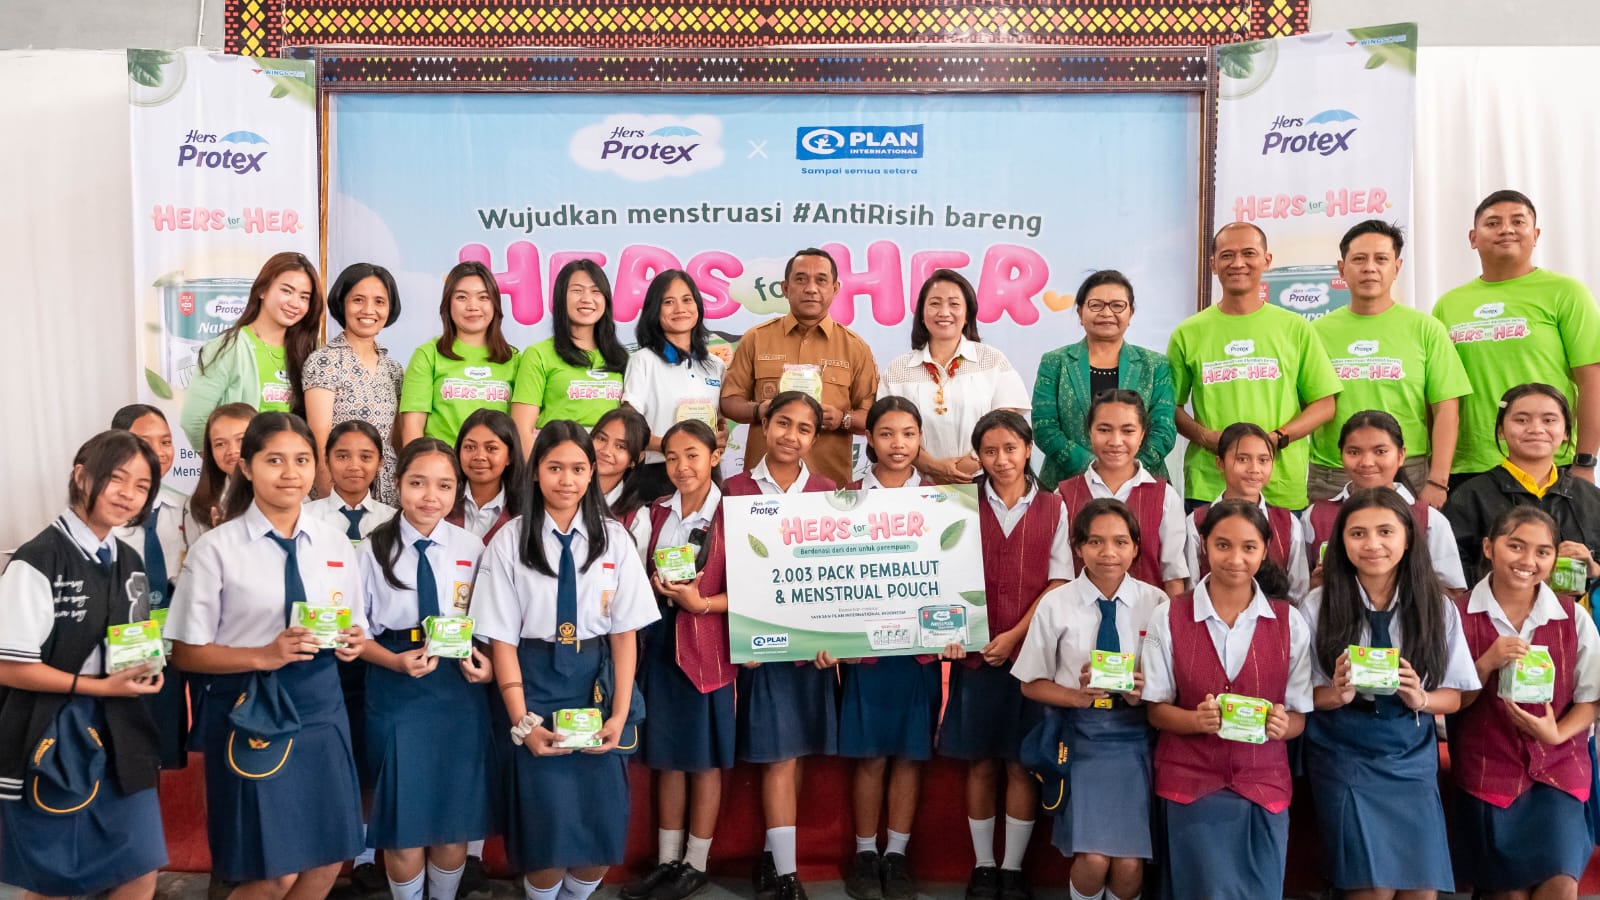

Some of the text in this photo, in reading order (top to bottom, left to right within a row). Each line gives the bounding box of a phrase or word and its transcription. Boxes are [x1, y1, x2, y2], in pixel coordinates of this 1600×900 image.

[610, 126, 645, 139] Hers
[1271, 115, 1304, 131] Hers
[185, 130, 217, 144] Hers
[850, 132, 918, 147] PLAN
[1262, 128, 1357, 156] Protex
[178, 144, 268, 175] Protex
[601, 140, 700, 165] Protex
[801, 167, 842, 176] Sampai
[1233, 187, 1388, 222] HERS for HER
[152, 204, 299, 233] HERS for HER
[478, 202, 1042, 237] Wujudkan menstruasi #AntiRisih bareng
[1289, 293, 1321, 303] Protex
[1494, 324, 1526, 339] HER
[1203, 368, 1238, 384] HERS
[1248, 365, 1278, 379] HER
[1335, 366, 1360, 379] ERS
[1370, 364, 1401, 379] HER
[750, 506, 780, 515] Protex
[781, 510, 925, 545] HERS for HER
[772, 560, 940, 584] 2.003 PACK PEMBALUT
[775, 580, 939, 604] & MENSTRUAL POUCH
